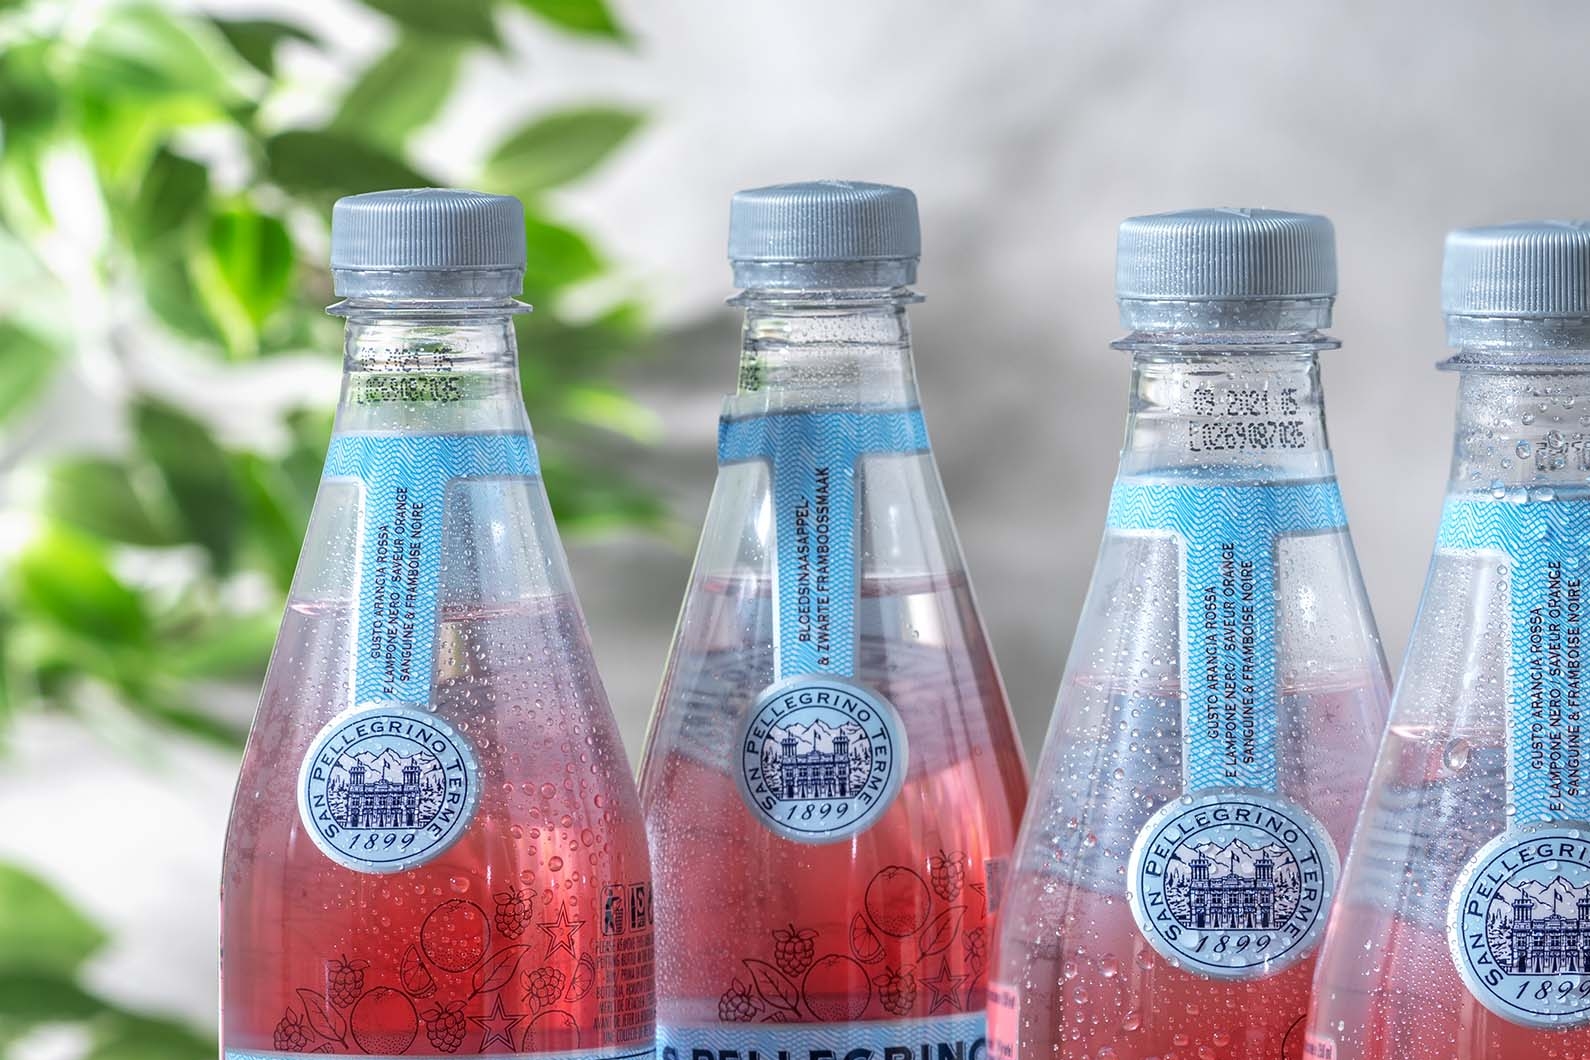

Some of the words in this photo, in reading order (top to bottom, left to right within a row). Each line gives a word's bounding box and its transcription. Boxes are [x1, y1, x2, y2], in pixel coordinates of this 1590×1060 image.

[314, 720, 448, 781] PELLEGRINO
[747, 693, 872, 754] PELLEGRINO
[750, 766, 778, 810] SAN
[859, 730, 887, 805] TERME
[314, 791, 340, 840] SAN
[430, 761, 462, 838] TERME
[787, 803, 849, 821] 1899
[349, 832, 416, 851] 1899
[1147, 808, 1300, 877] PELLEGRINO
[1150, 888, 1181, 942] SAN
[1284, 851, 1319, 937] TERME
[1194, 934, 1272, 954] 1899
[1469, 931, 1504, 988] SAN
